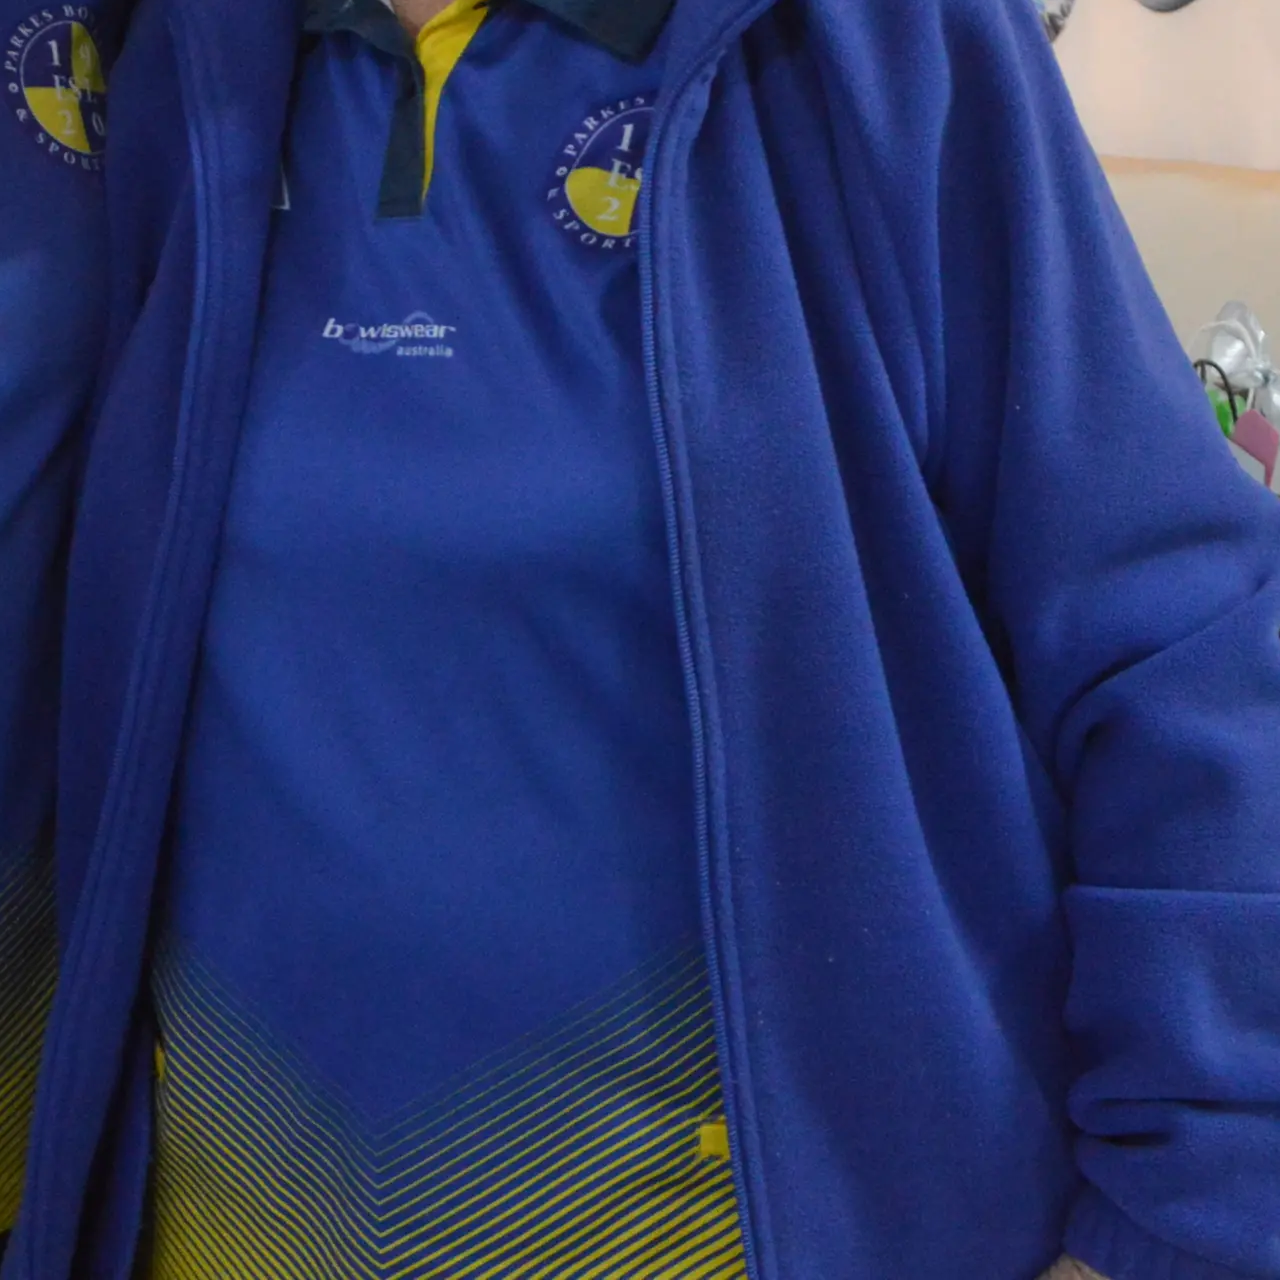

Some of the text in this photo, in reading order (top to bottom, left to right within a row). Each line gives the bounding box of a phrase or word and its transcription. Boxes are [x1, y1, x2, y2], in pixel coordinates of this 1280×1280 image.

[3, 8, 54, 73] PARKES
[562, 96, 646, 157] PARKES
[396, 343, 454, 358] australia
